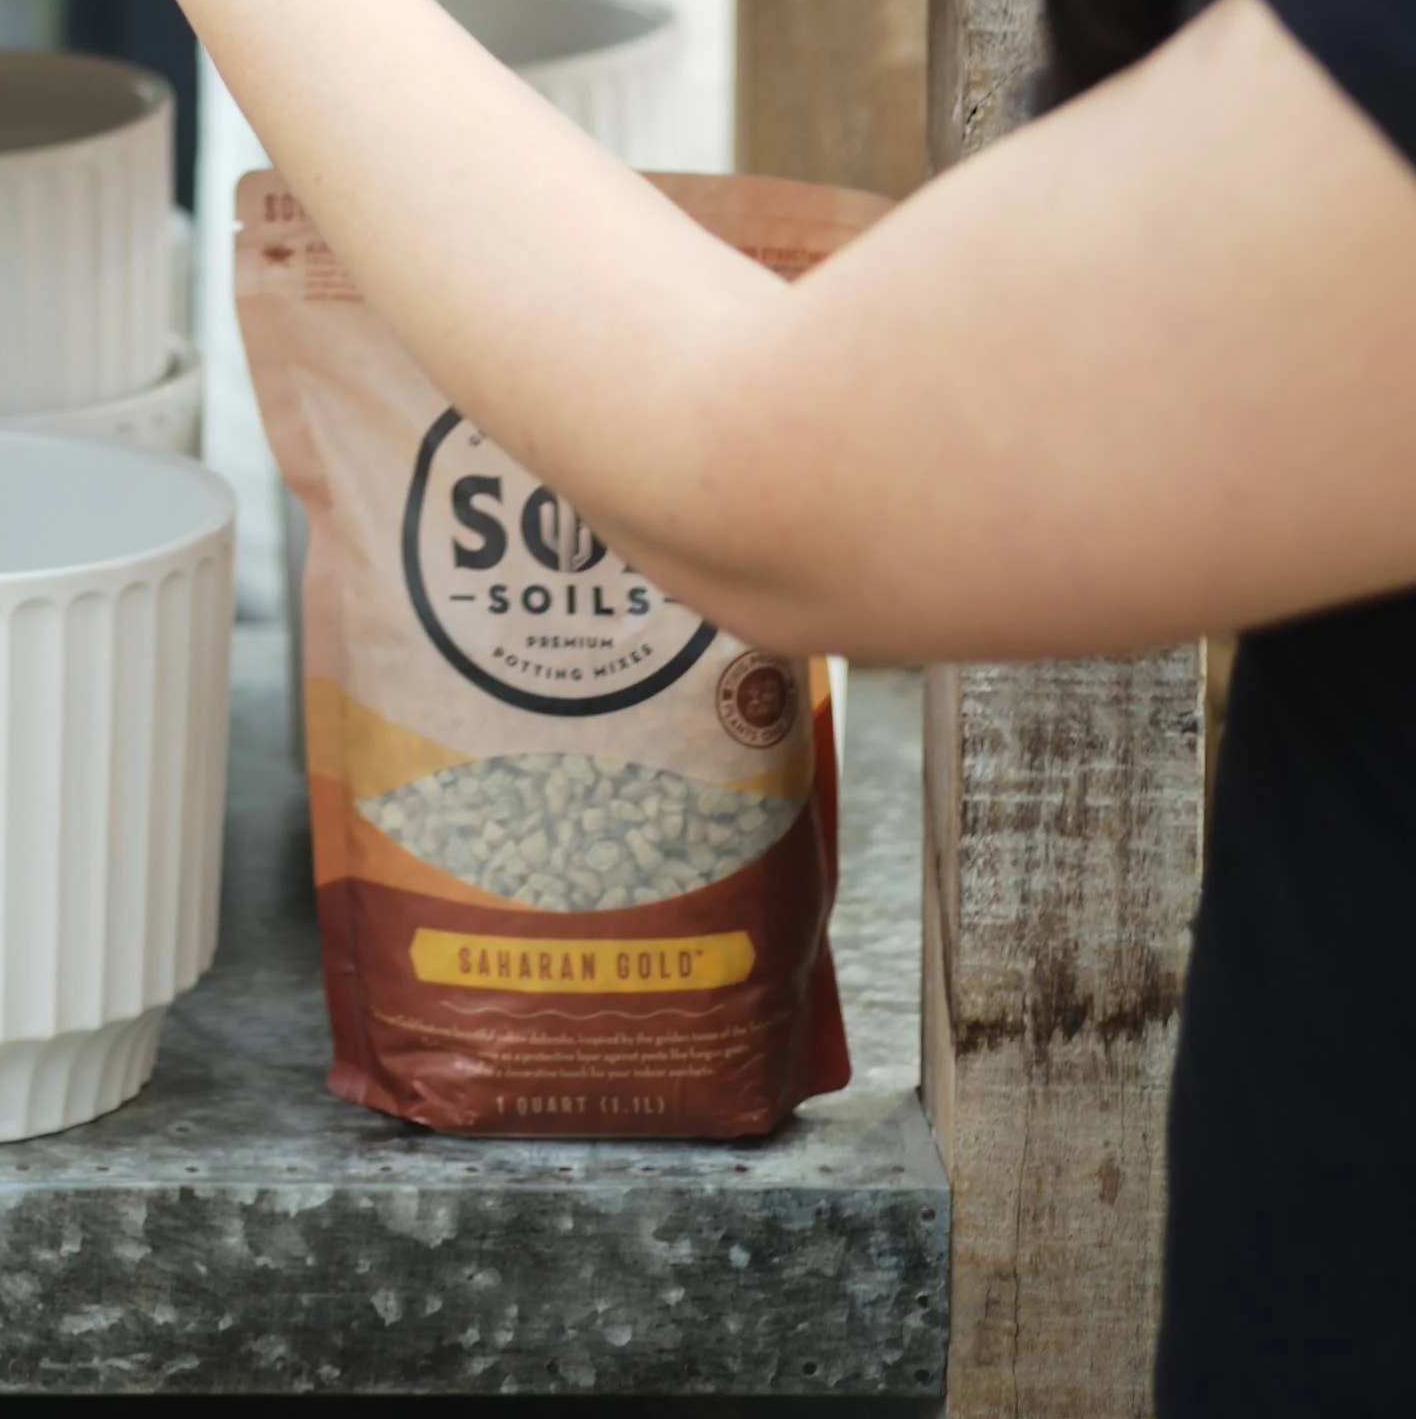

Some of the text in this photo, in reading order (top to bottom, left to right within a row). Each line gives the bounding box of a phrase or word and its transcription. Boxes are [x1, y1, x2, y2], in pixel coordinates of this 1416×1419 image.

[450, 475, 653, 573] SO
[487, 584, 650, 616] SOILS
[527, 636, 614, 649] PREMIUM
[492, 643, 653, 682] POTTING MIXES
[458, 947, 596, 981] SAHARAN
[517, 1095, 585, 1114] QUART
[600, 1096, 666, 1114] (1.1L)
